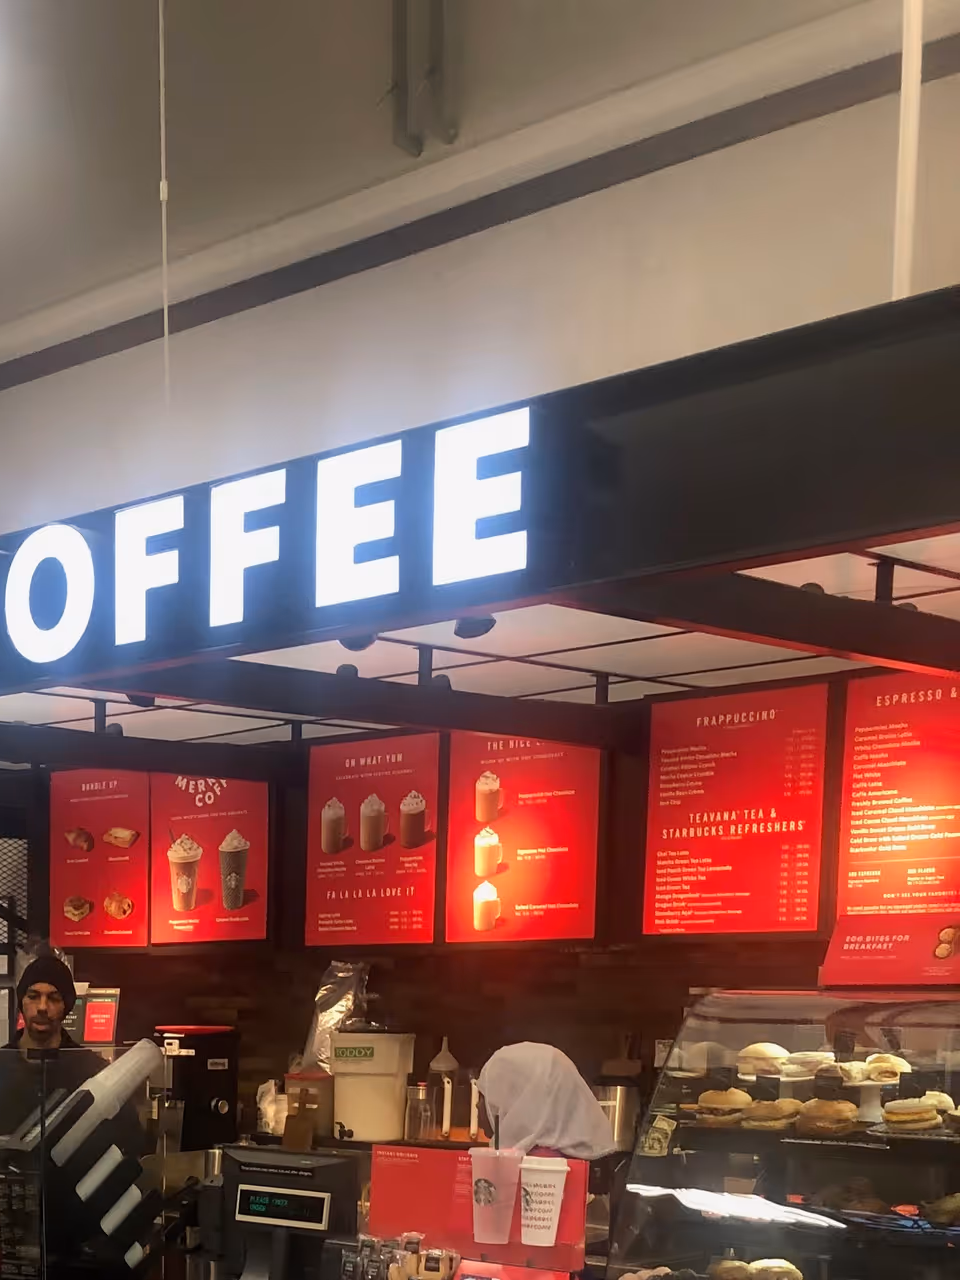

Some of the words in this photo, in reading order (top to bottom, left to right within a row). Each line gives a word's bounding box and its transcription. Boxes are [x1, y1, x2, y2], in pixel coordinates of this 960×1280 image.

[876, 689, 942, 707] ESPRESSO
[951, 687, 957, 698] &
[696, 708, 777, 727] FRAPPUCCINO
[487, 740, 504, 751] THE
[360, 755, 382, 767] WHAT
[744, 808, 764, 820] TEA
[770, 807, 777, 818] &
[662, 825, 724, 839] STARBUCKS
[730, 821, 804, 834] REFRESHERS
[340, 890, 349, 899] LA
[353, 889, 363, 899] LA
[366, 888, 377, 898] LA
[381, 887, 402, 897] LOVE
[406, 886, 415, 897] IT
[843, 943, 894, 951] BREAKFAST
